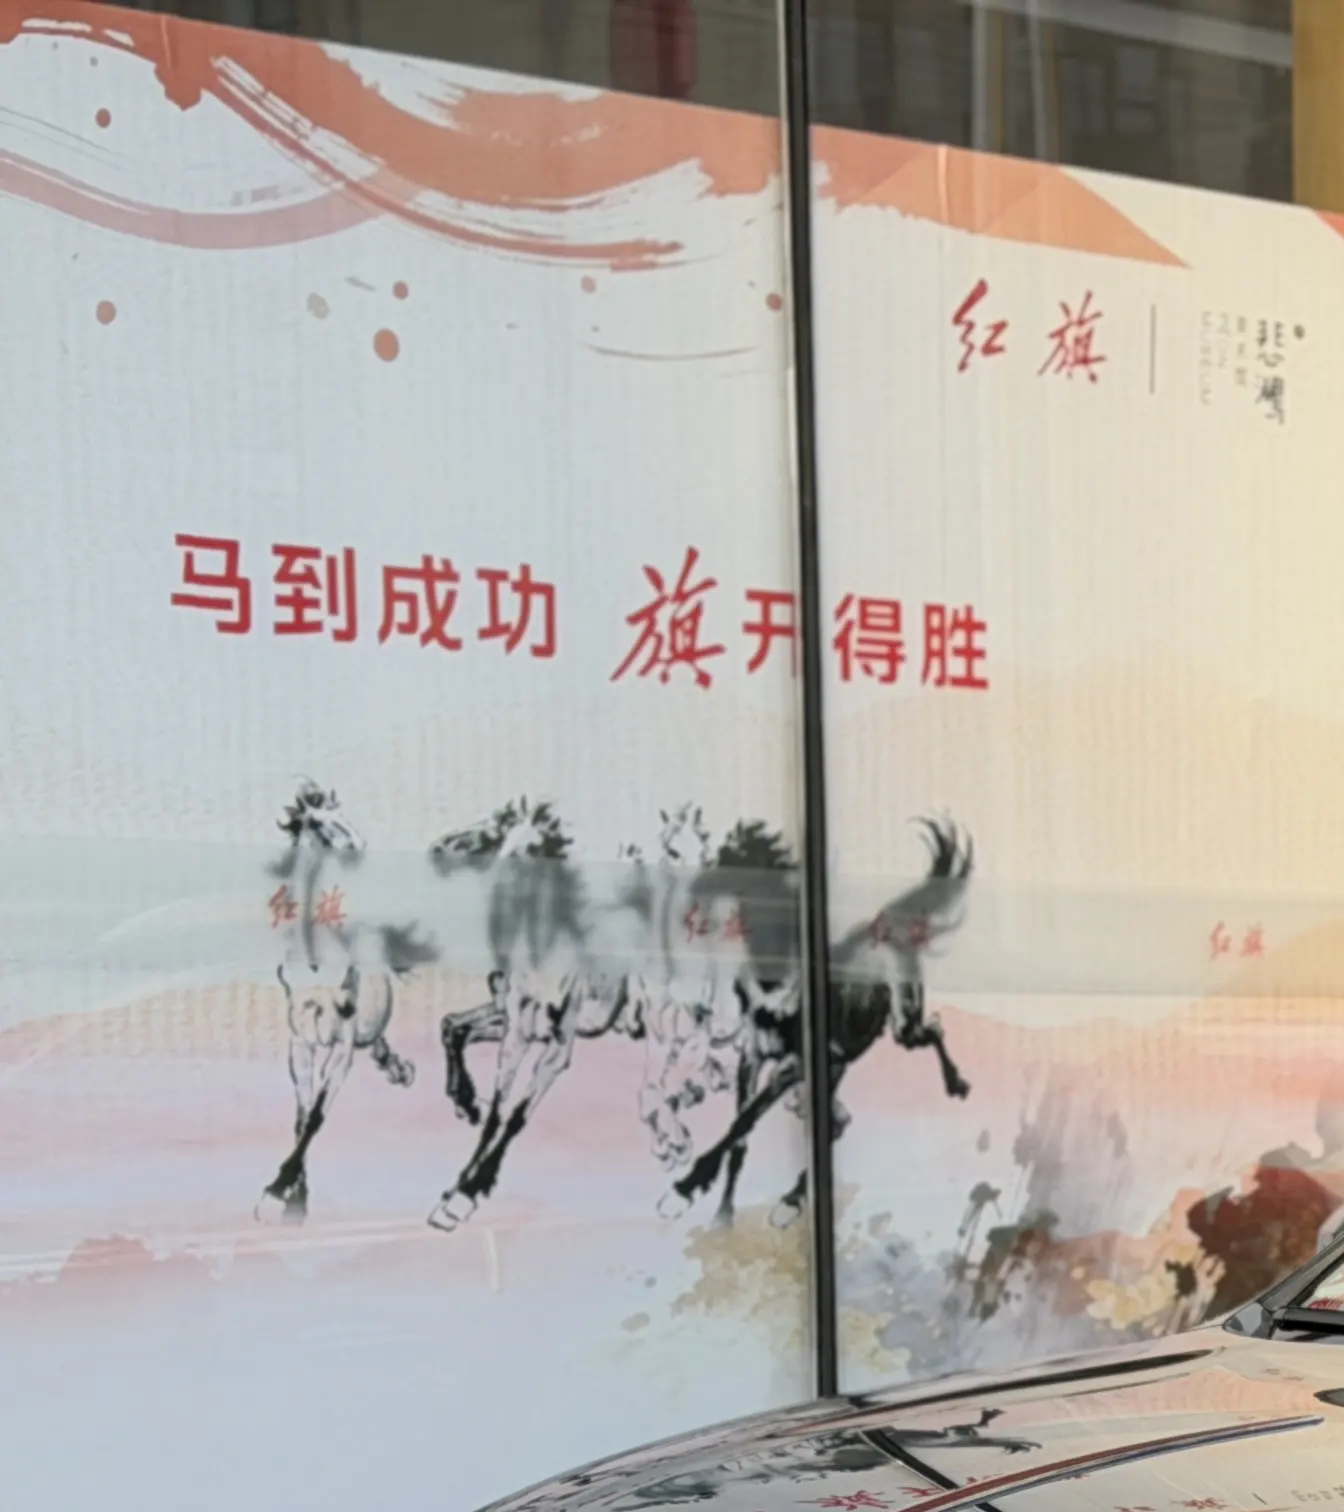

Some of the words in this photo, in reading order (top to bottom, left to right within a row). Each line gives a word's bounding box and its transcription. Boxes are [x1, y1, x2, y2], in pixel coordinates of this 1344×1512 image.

[951, 277, 1107, 385] 红旗
[170, 533, 557, 660] 马到成功
[608, 545, 990, 691] 旗开得胜
[268, 884, 348, 930] 红旗
